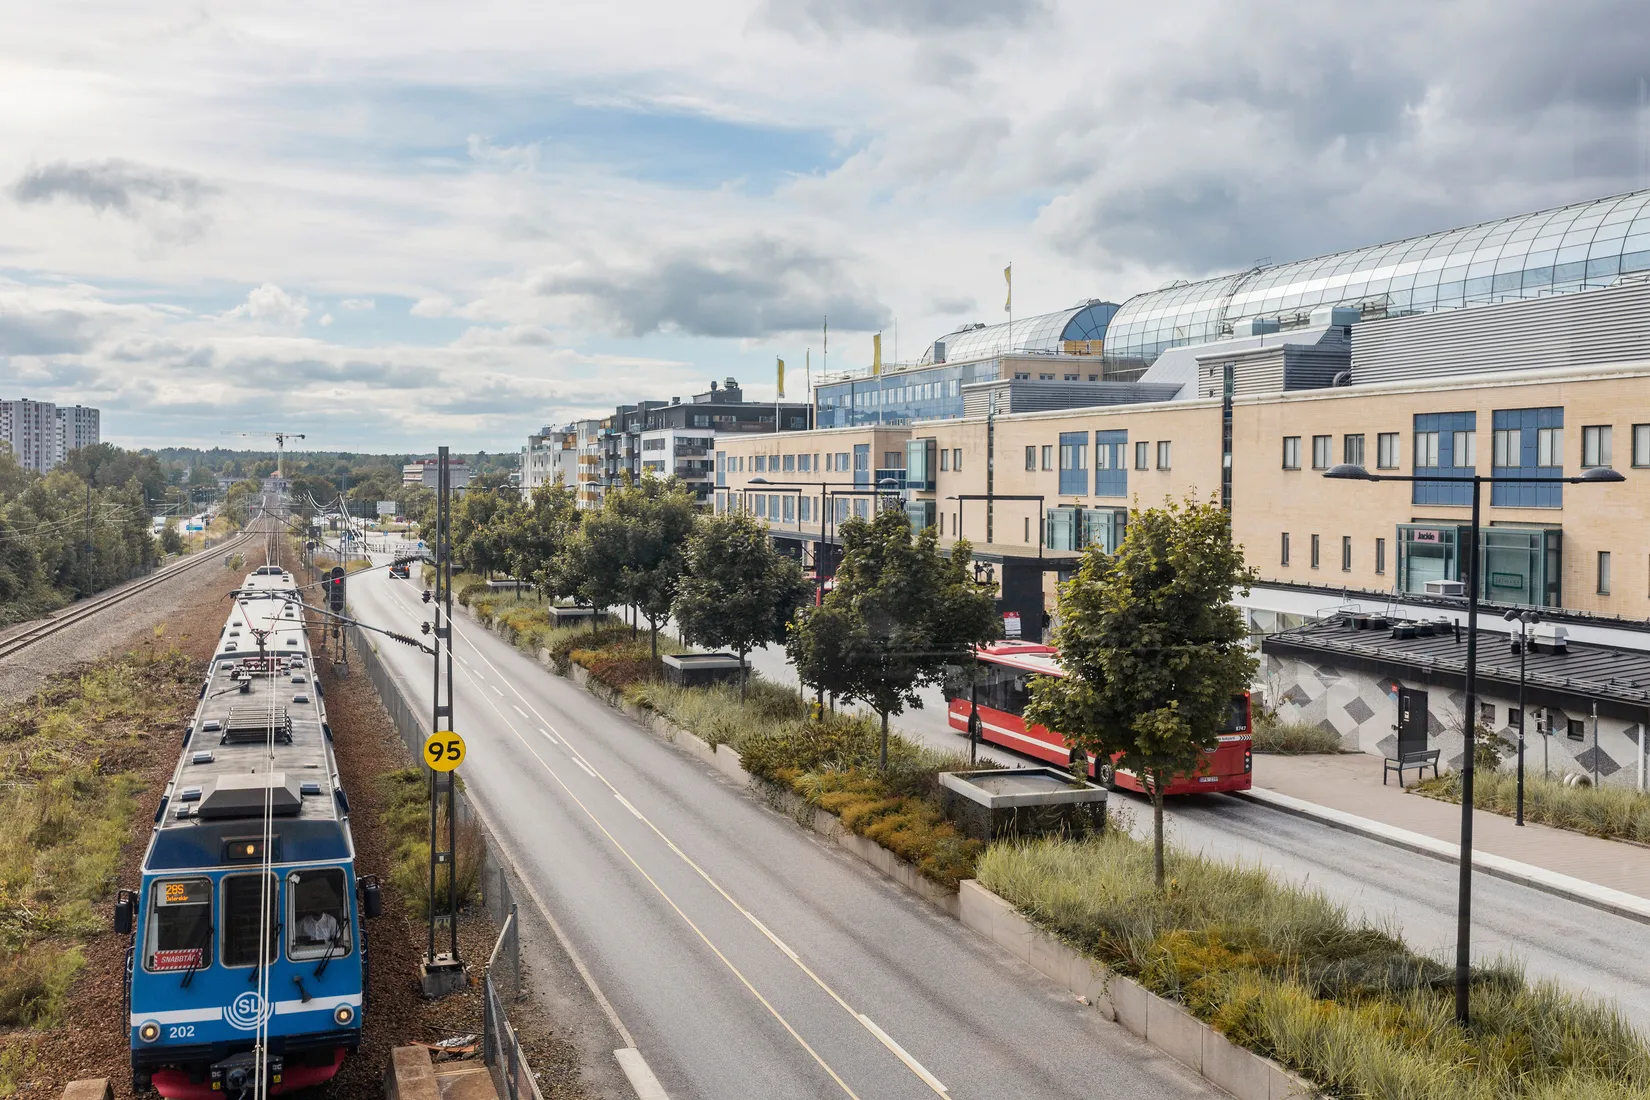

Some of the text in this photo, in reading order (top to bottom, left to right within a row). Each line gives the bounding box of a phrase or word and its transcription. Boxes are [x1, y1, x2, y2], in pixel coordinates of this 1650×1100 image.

[1417, 531, 1435, 540] Jackie
[428, 740, 461, 762] 95
[238, 998, 260, 1014] SL
[169, 1025, 195, 1039] 202
